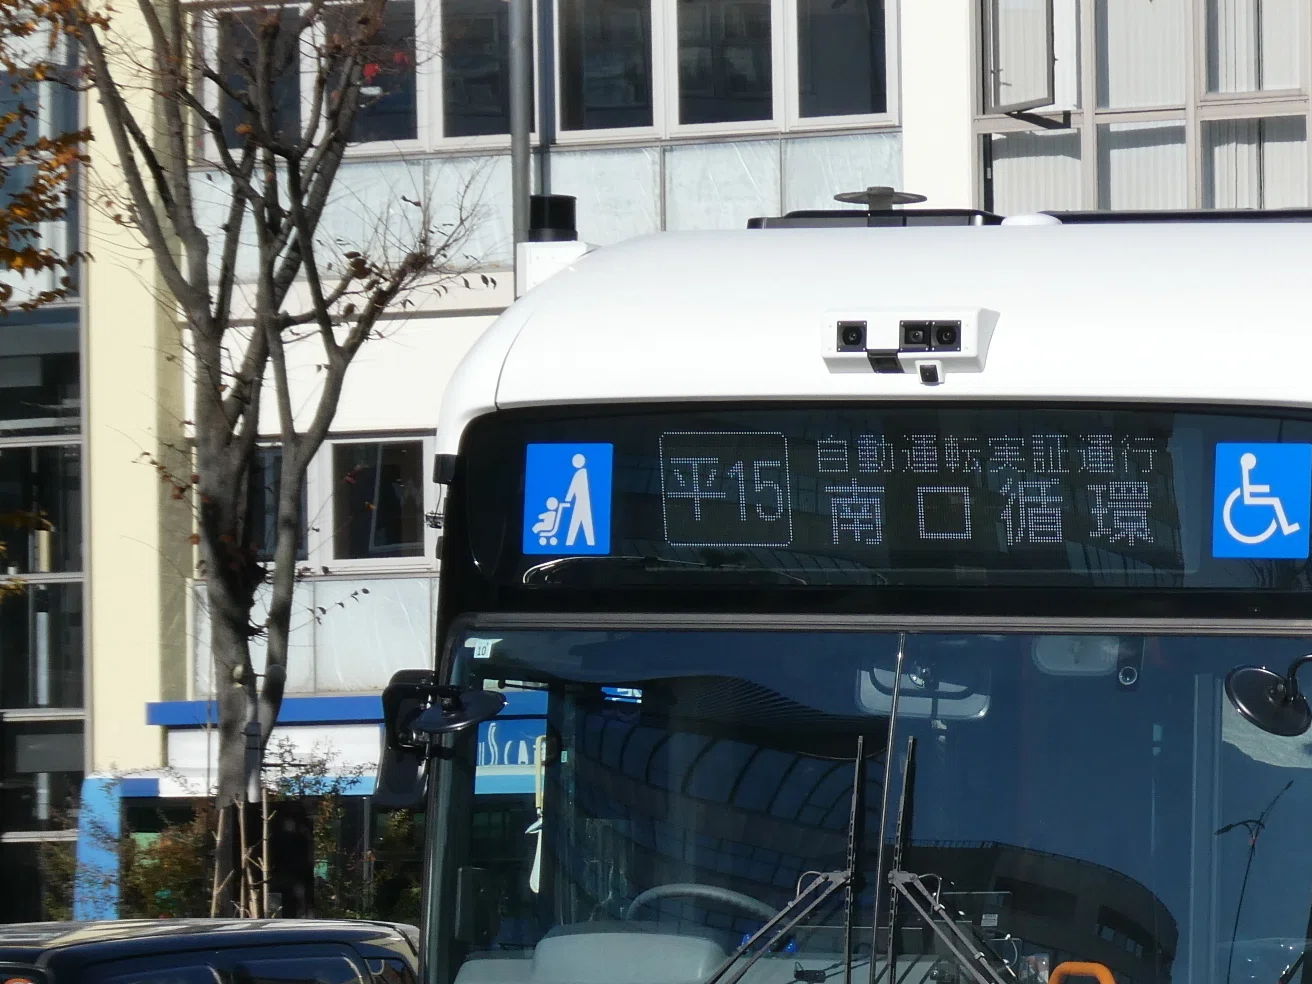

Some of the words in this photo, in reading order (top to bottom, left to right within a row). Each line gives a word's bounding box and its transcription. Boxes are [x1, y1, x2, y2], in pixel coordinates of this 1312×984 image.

[817, 434, 1158, 474] 自動運転実証運行
[666, 457, 784, 521] 平15
[825, 477, 1154, 546] 南口循環
